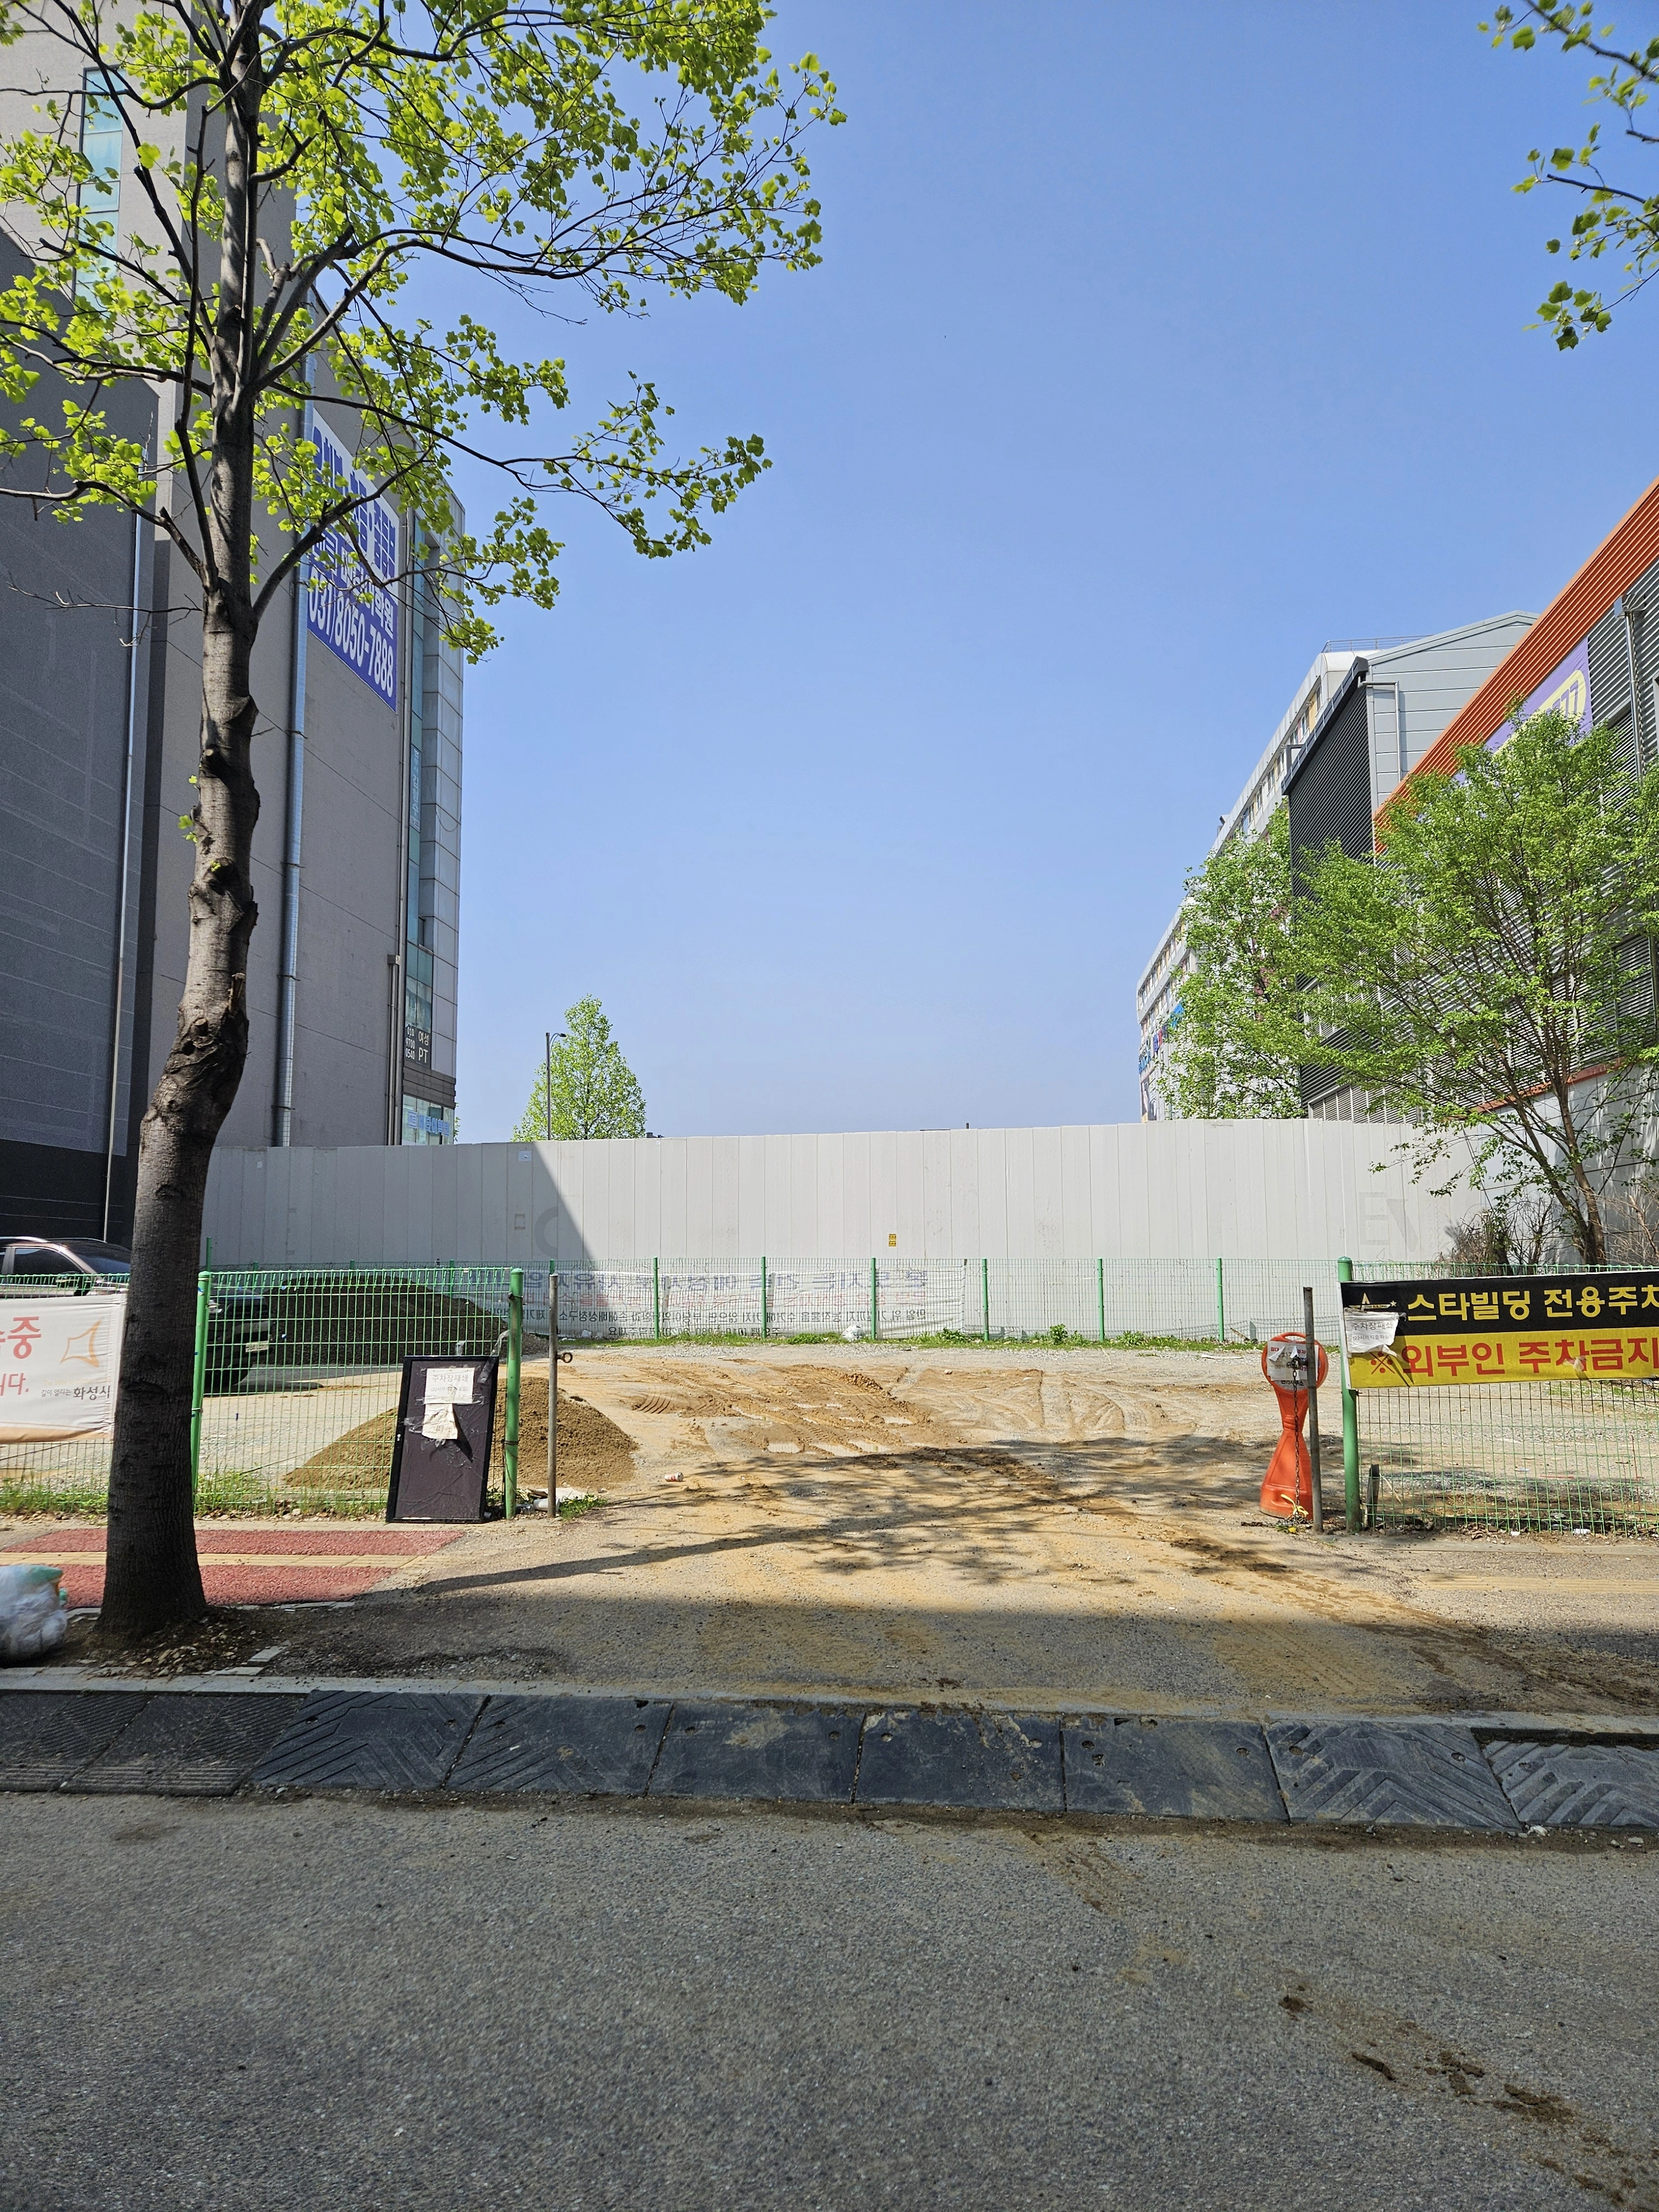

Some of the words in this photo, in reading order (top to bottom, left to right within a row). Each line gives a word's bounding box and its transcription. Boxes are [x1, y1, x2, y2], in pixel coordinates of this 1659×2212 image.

[309, 566, 394, 698] 031)8050-7888
[419, 1031, 429, 1046] 여성
[419, 1048, 429, 1063] PT
[1408, 1290, 1530, 1321] 스타빌딩
[0, 1316, 41, 1359] 중
[1403, 1343, 1505, 1377] 외부인
[1519, 1337, 1659, 1374] 주차금지
[54, 1388, 72, 1397] 열리는
[72, 1385, 111, 1400] 화성시
